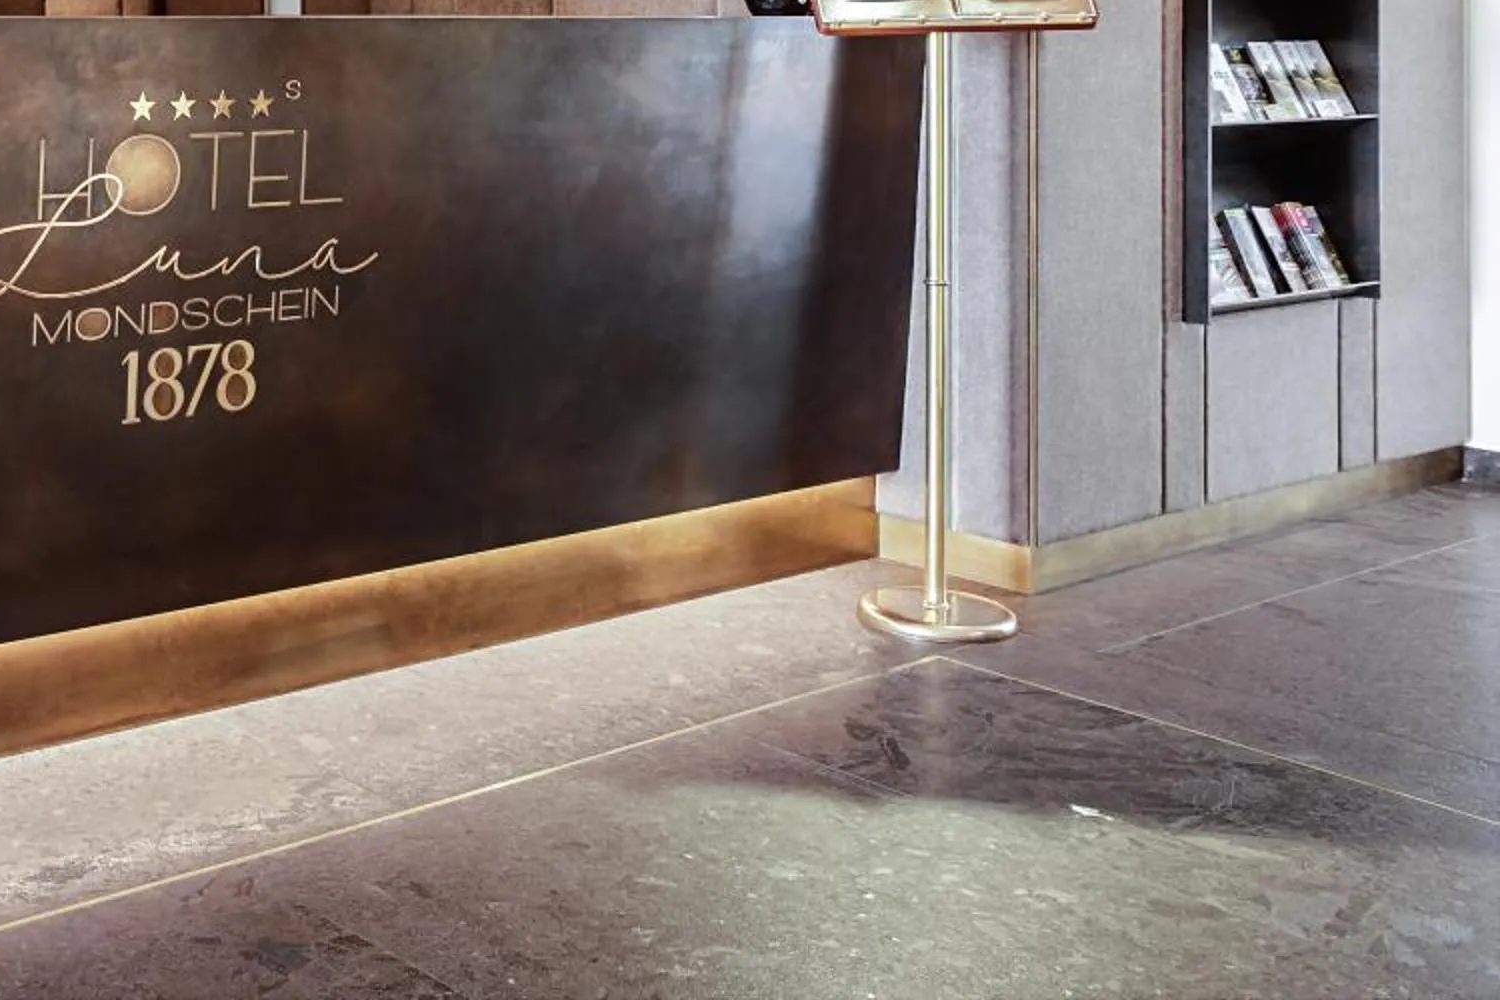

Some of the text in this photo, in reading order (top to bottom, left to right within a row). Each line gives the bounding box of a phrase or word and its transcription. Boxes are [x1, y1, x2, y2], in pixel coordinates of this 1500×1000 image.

[284, 80, 302, 100] S
[36, 129, 344, 221] HOTEL
[31, 285, 341, 348] MONDSCHEIN
[120, 339, 258, 426] 1878
